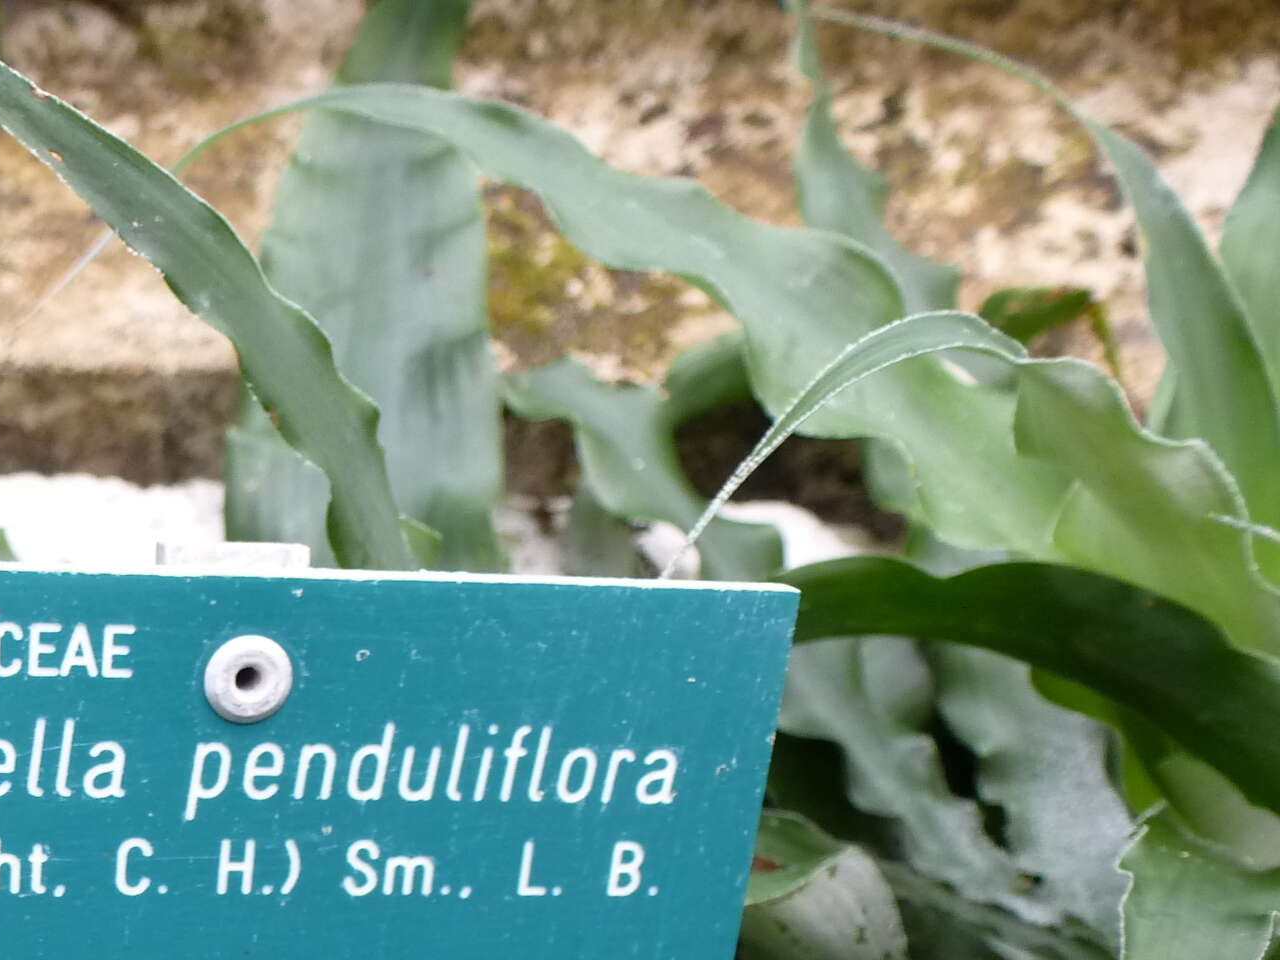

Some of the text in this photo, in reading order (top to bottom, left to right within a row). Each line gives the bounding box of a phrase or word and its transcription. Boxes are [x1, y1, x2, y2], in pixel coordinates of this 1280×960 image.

[183, 721, 680, 822] penduliflora
[114, 837, 169, 897] C.
[216, 838, 301, 897] H.)
[517, 840, 562, 897] L.
[606, 840, 659, 897] B.
